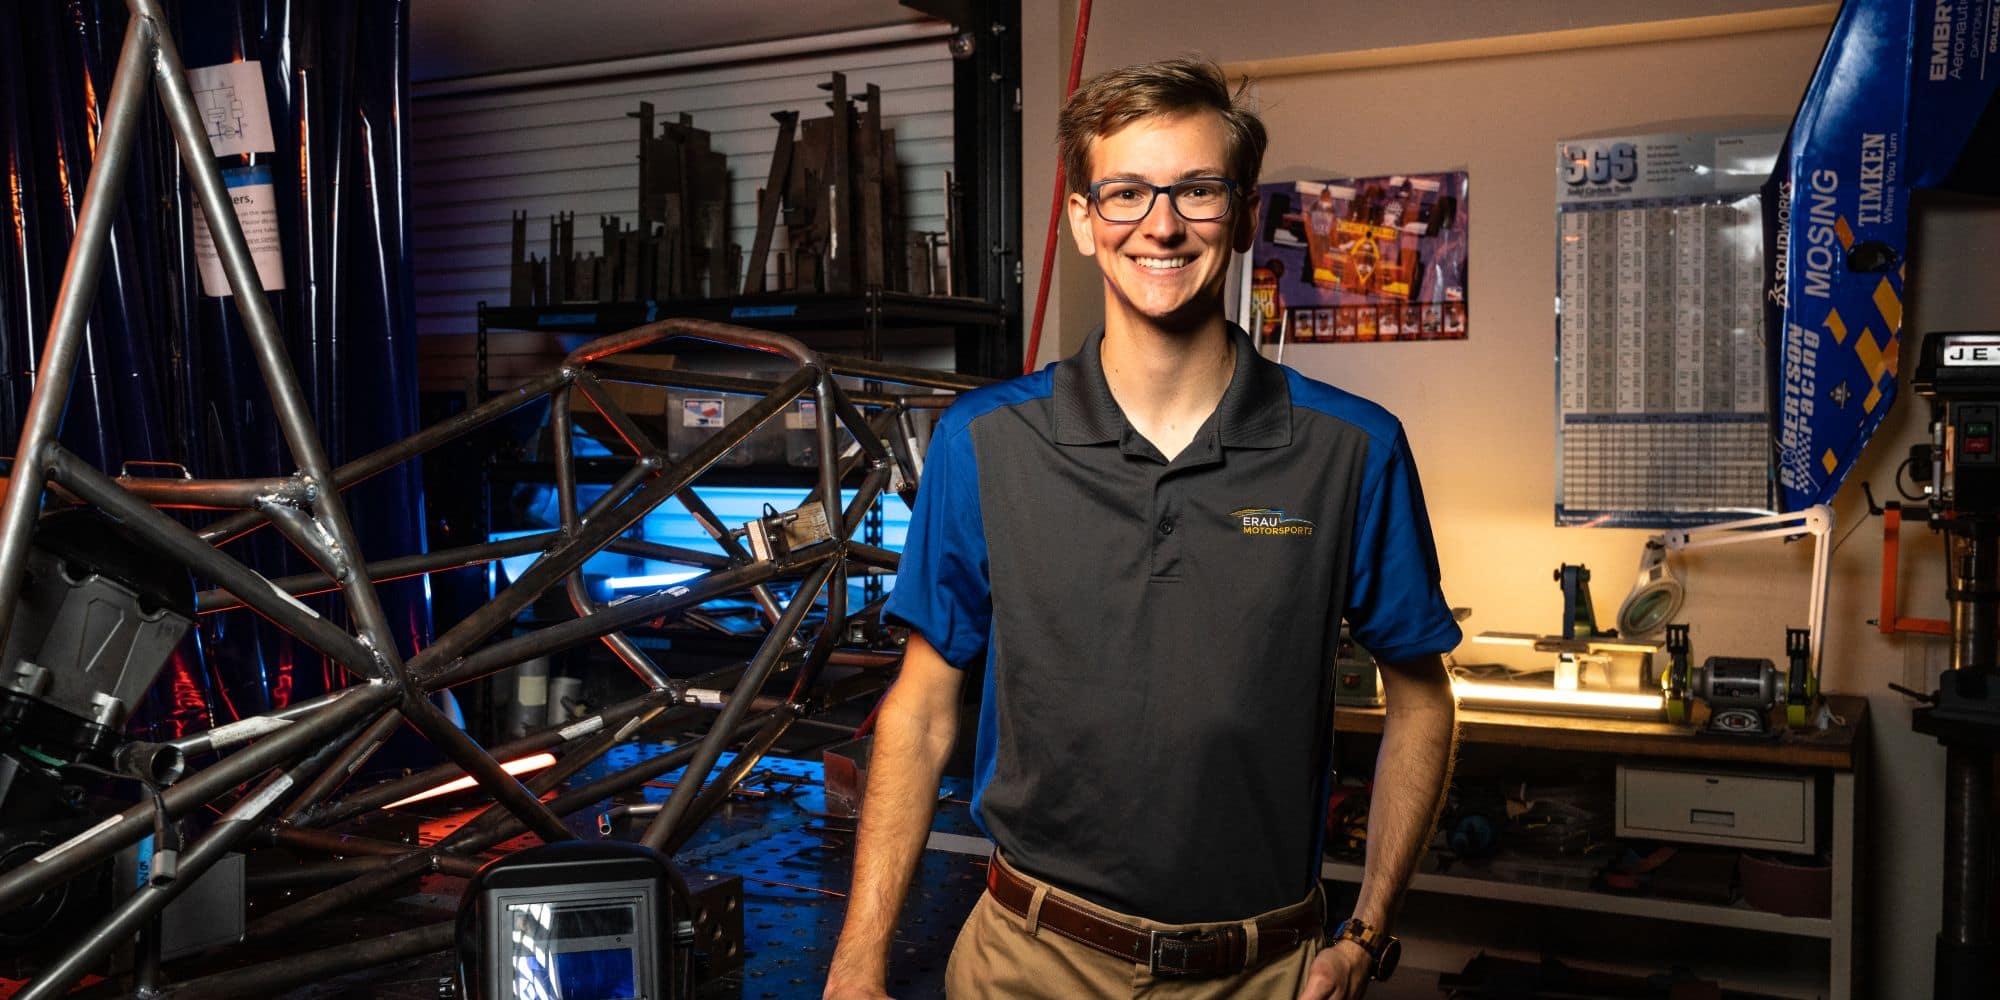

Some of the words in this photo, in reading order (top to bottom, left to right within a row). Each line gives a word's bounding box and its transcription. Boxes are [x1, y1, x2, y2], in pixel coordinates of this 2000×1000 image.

[1949, 0, 1969, 80] Aeronauti
[1562, 142, 1638, 186] SGS
[1886, 132, 1898, 160] Turn
[1858, 133, 1886, 227] TIMKEN
[1884, 160, 1897, 184] You
[1882, 186, 1896, 225] Where
[1774, 180, 1793, 281] SOLIDWORKS
[1804, 169, 1839, 299] MOSING
[1252, 288, 1274, 302] NDY
[1949, 347, 2000, 361] JE
[1798, 327, 1821, 436] racing
[1780, 323, 1804, 488] ROBERTSON
[1242, 516, 1278, 527] ERAU
[1243, 526, 1313, 536] MOTORSPORTS
